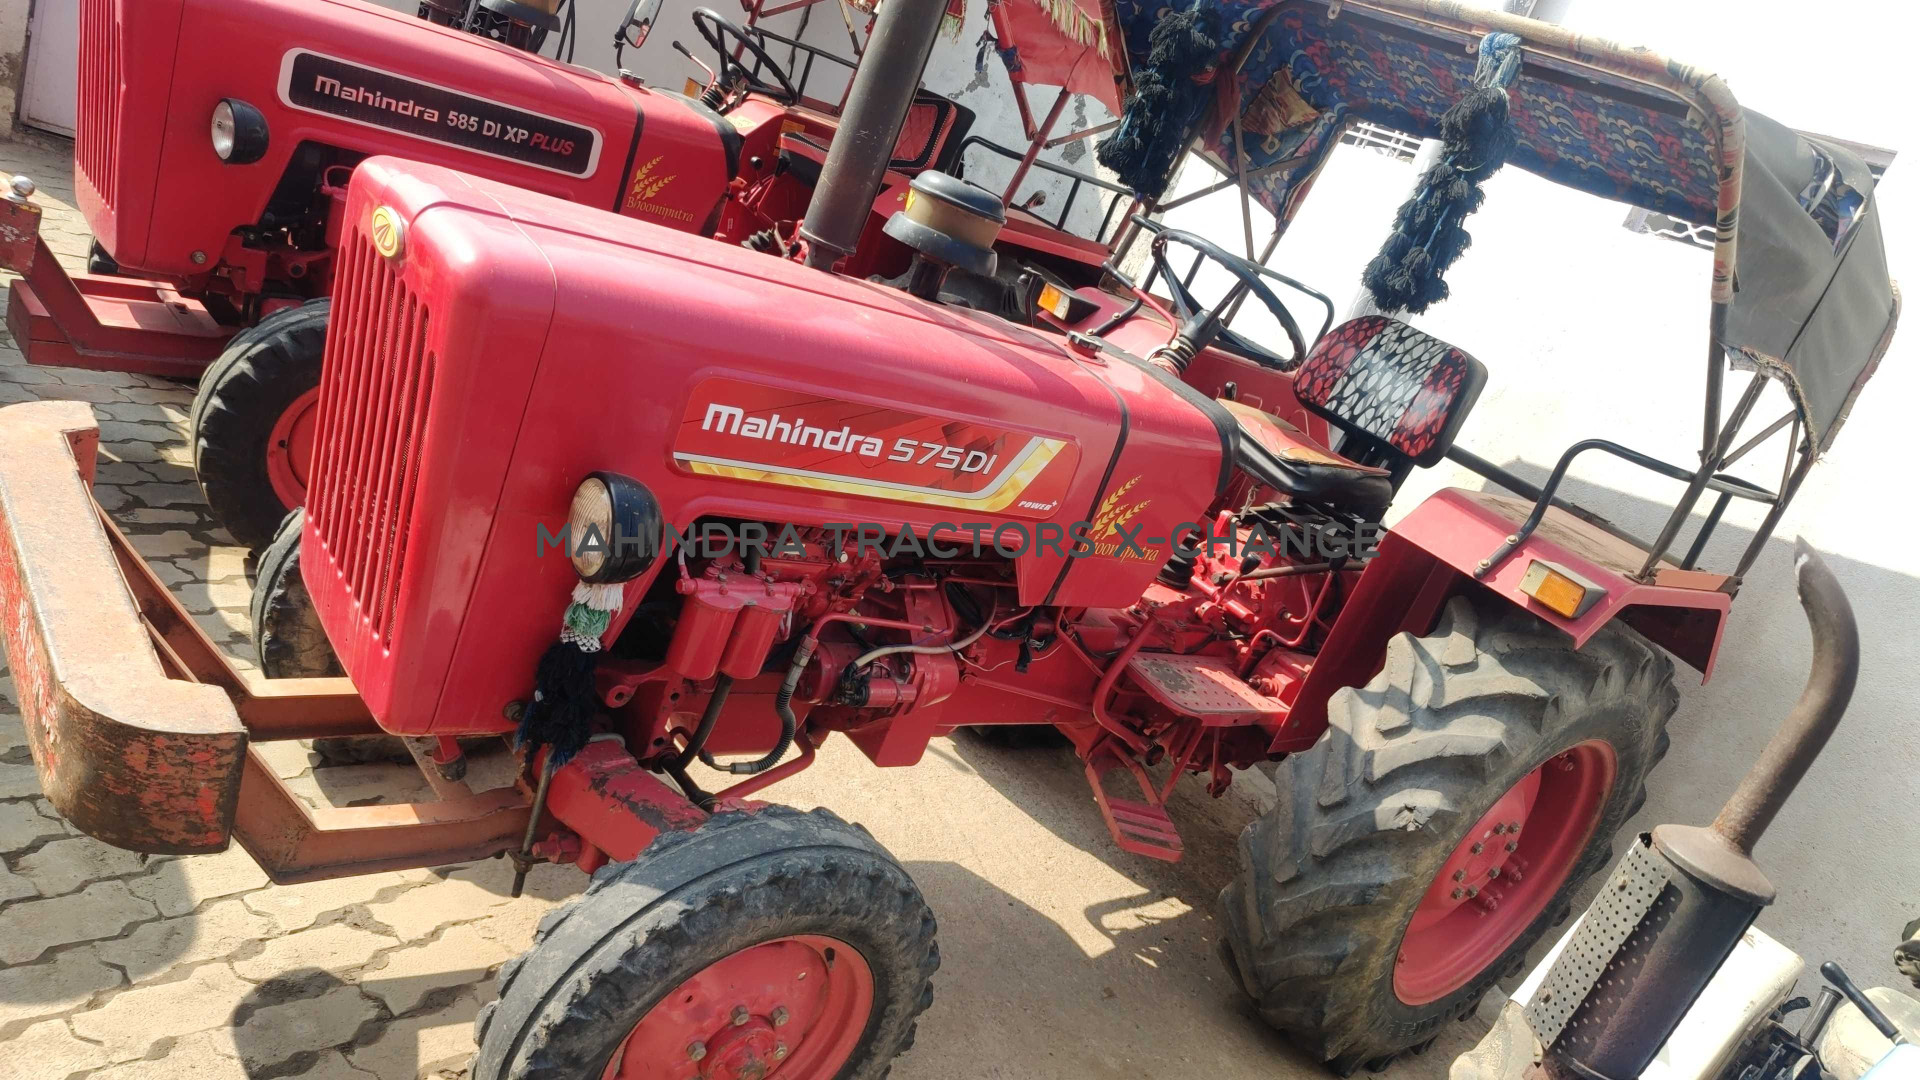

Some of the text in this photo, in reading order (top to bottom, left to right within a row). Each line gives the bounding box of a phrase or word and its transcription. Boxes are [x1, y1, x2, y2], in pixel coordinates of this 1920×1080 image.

[447, 110, 478, 133] 585
[482, 120, 501, 139] DI
[506, 125, 529, 145] XP
[530, 131, 575, 157] PLUS
